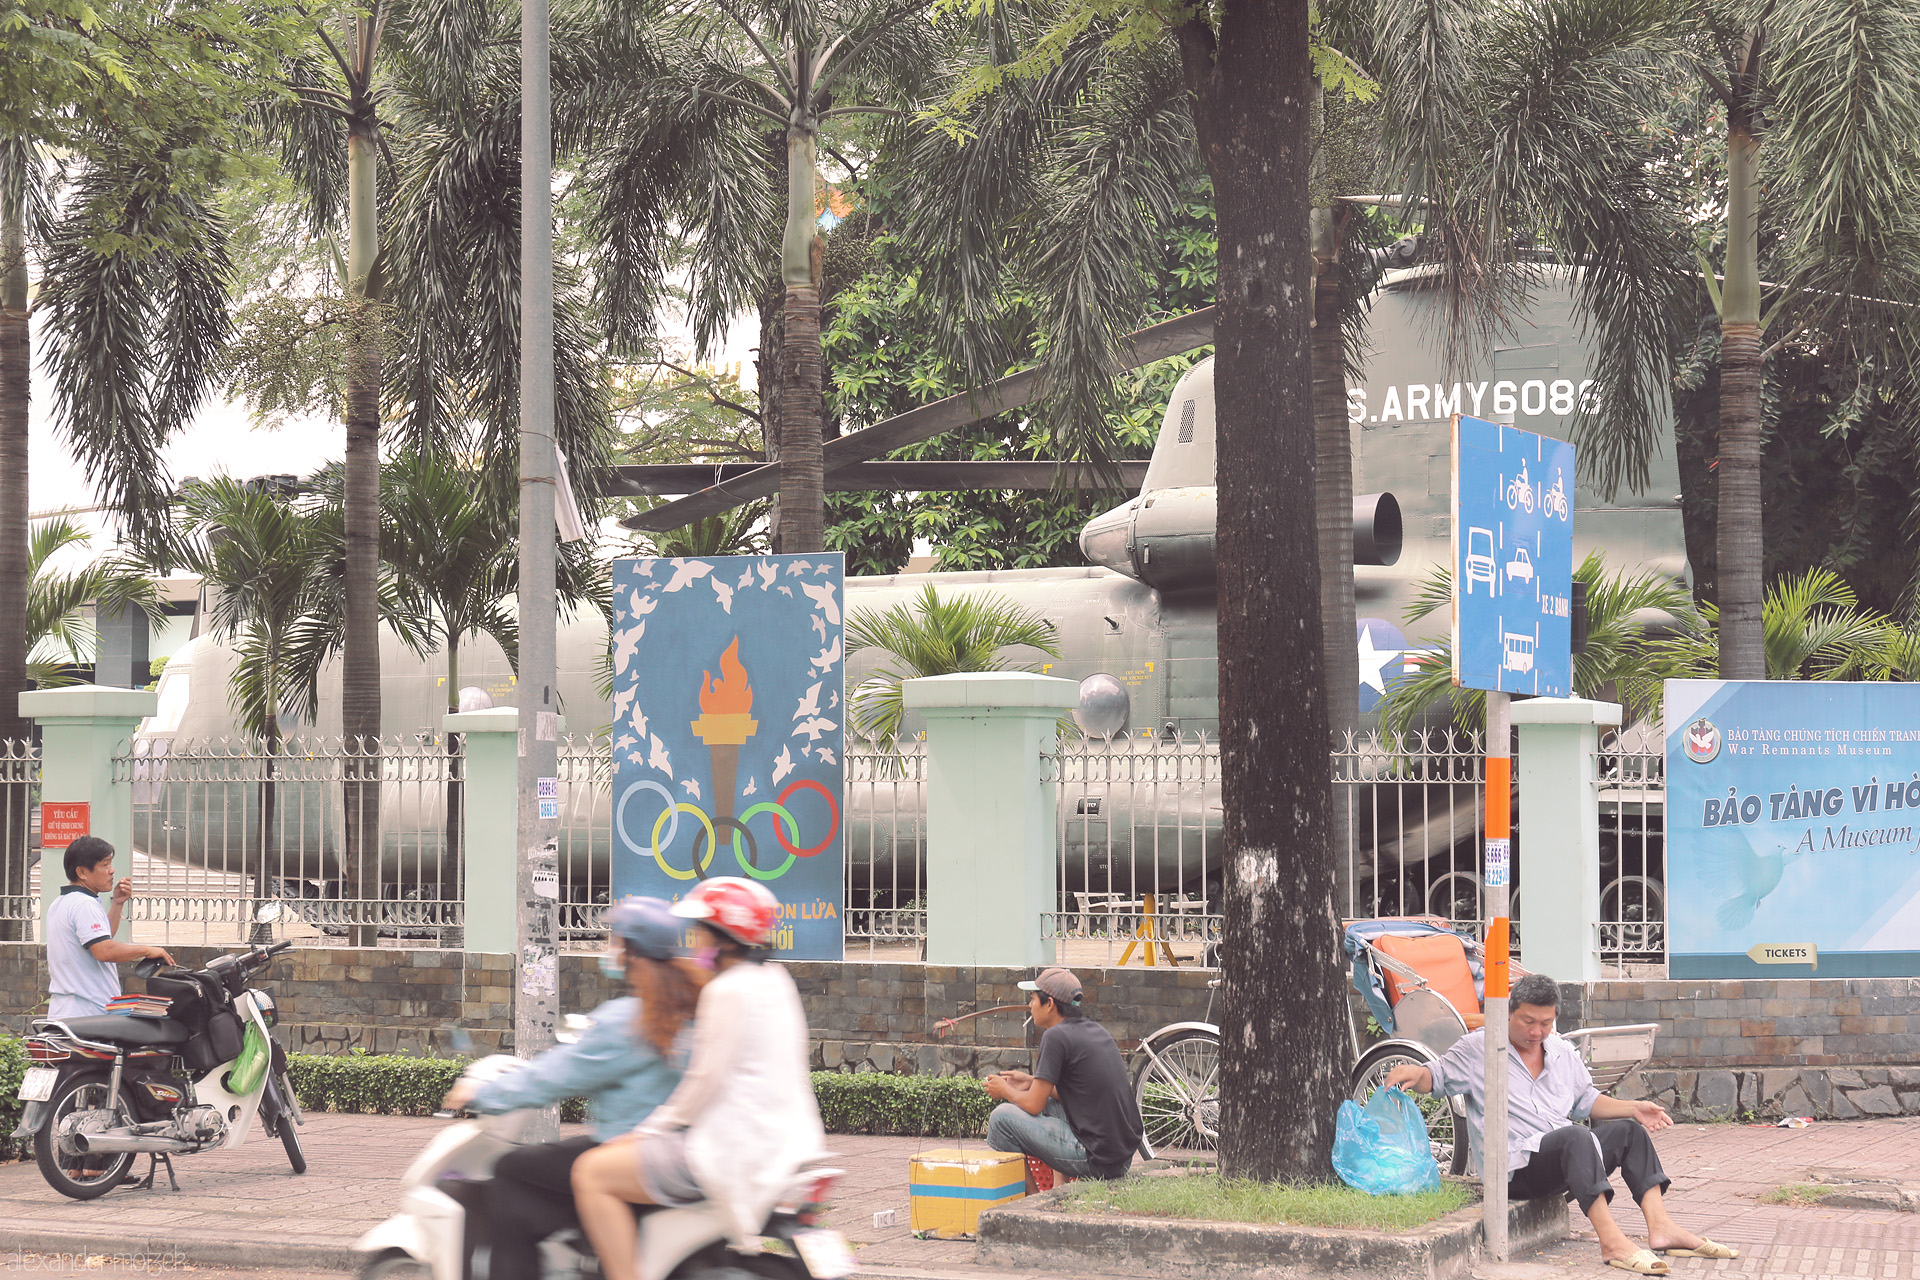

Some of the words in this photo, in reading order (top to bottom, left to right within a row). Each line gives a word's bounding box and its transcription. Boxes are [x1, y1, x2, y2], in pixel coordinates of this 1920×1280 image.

[1541, 594, 1549, 615] XE
[1550, 595, 1554, 615] 2
[1728, 727, 1750, 741] BẢO
[1752, 727, 1782, 741] TÀNG
[1825, 727, 1850, 742] TÍCH
[1852, 726, 1886, 742] CHIẾN
[1728, 744, 1755, 755] War
[1761, 743, 1831, 755] Remnants
[1837, 744, 1893, 755] Museum
[1702, 786, 1762, 828] BẢO
[1769, 783, 1844, 822] TÀNG
[1851, 775, 1880, 815] VÌ
[1884, 772, 1920, 811] HÒ
[1795, 826, 1816, 854] A
[1821, 824, 1913, 853] Museum
[801, 897, 838, 919] LỬA
[1765, 949, 1807, 958] TICKETS
